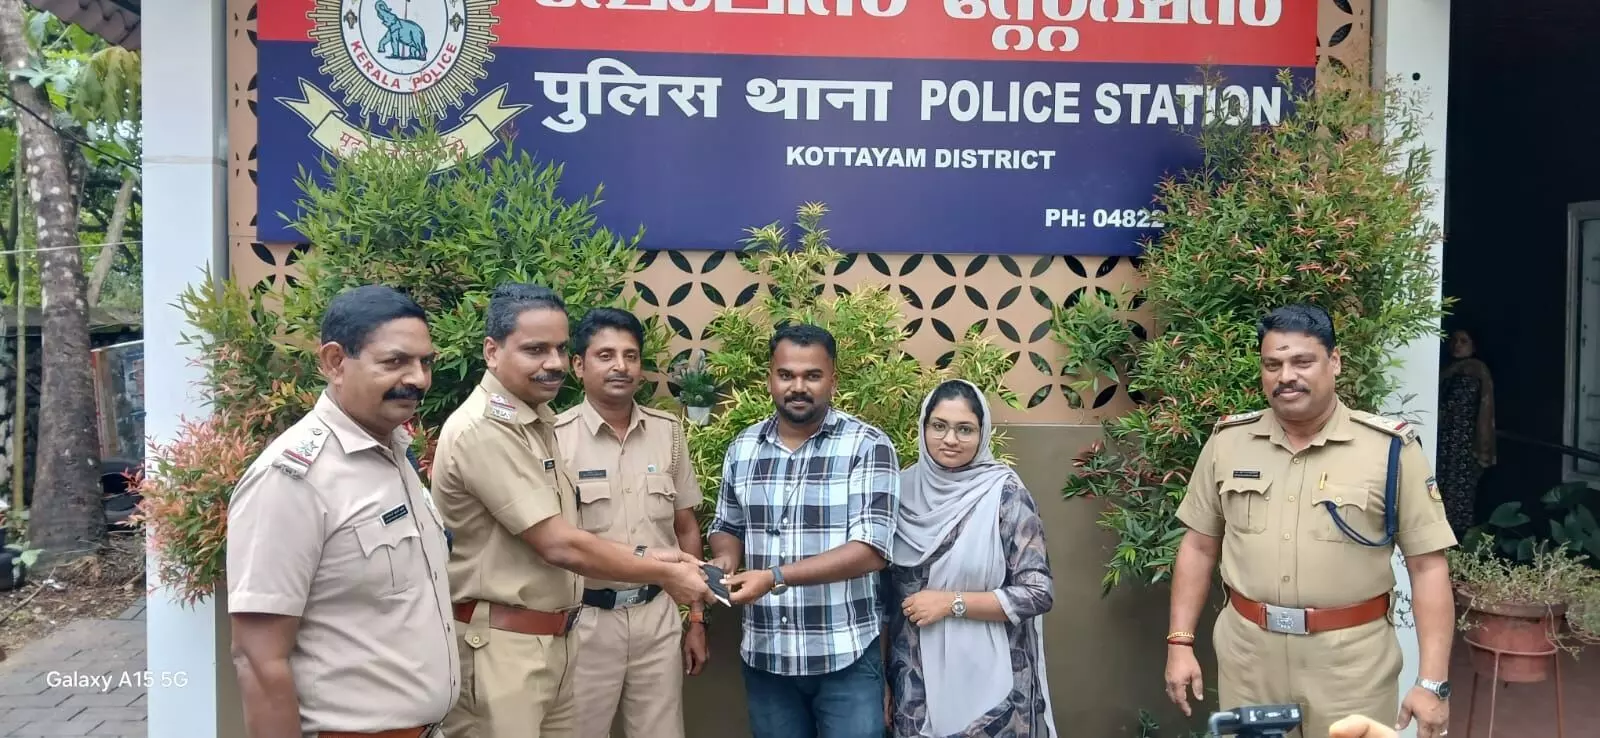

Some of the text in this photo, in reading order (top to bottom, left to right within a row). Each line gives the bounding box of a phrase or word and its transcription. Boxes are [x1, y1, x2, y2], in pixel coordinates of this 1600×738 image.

[350, 40, 457, 90] KERALA POLICE
[534, 57, 893, 133] पुलिस थाना
[920, 79, 1282, 127] POLICE STATION
[786, 145, 1056, 170] KOTTAYAM DISTRICT
[1045, 208, 1086, 227] PH:
